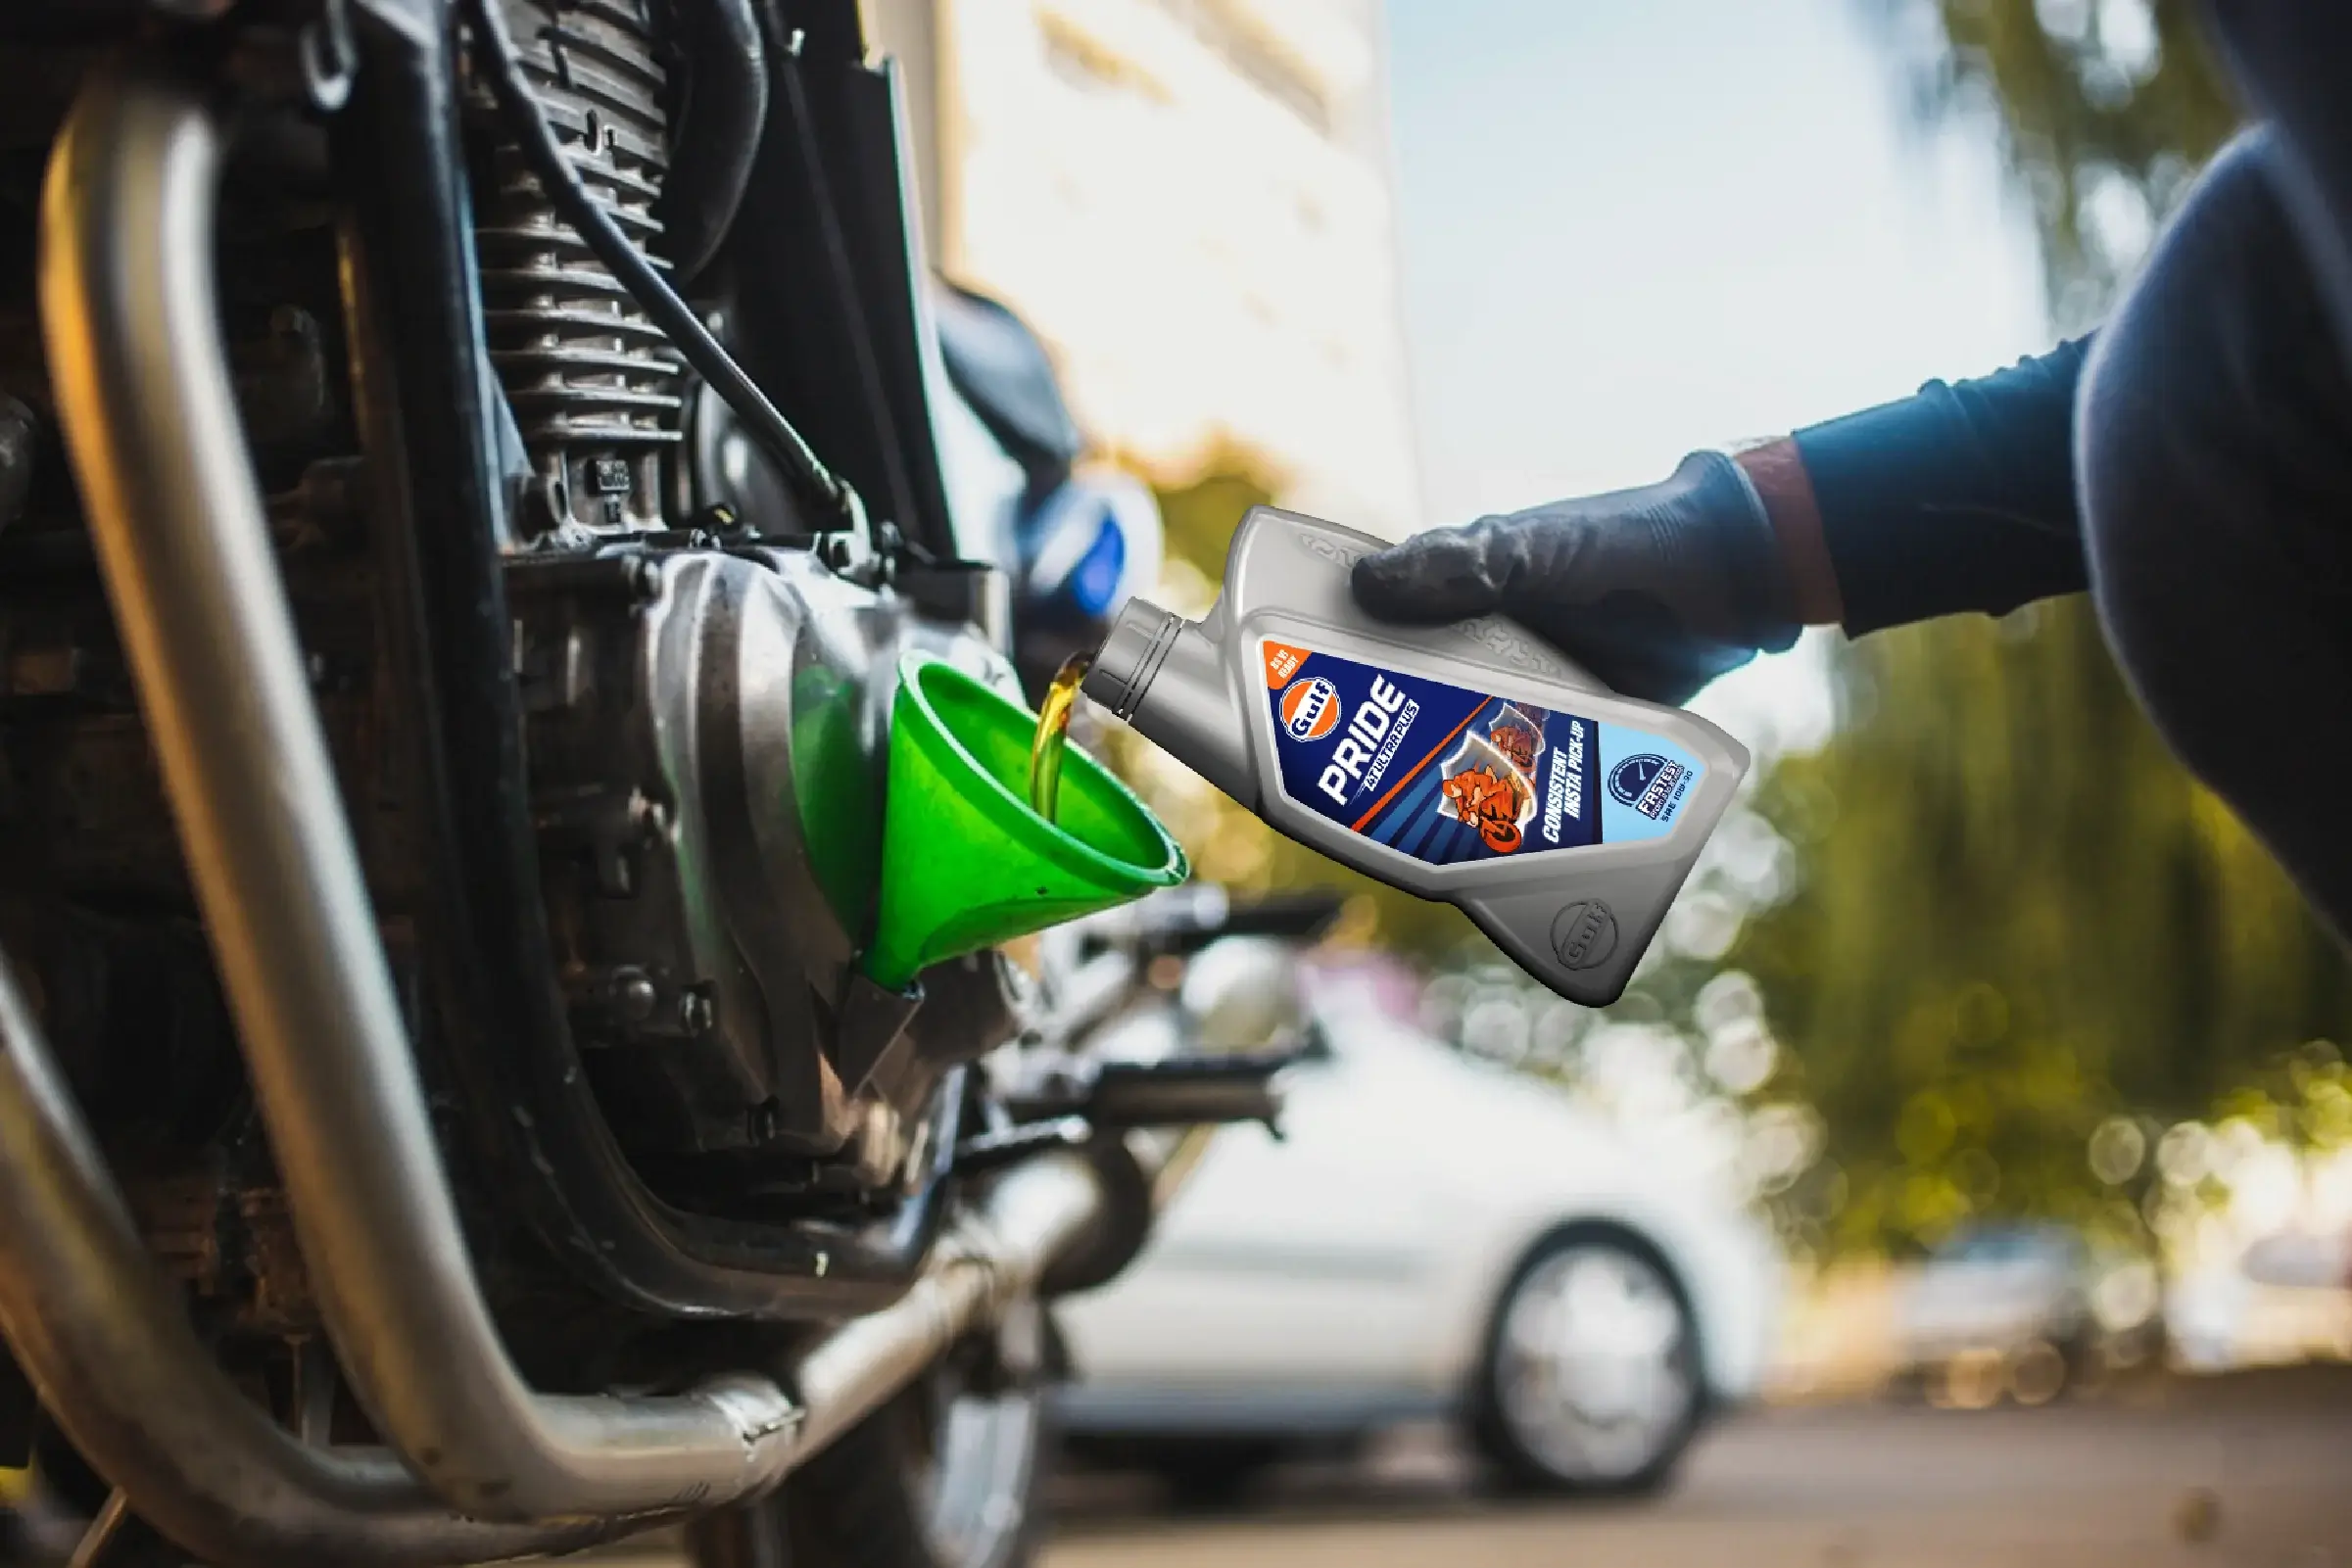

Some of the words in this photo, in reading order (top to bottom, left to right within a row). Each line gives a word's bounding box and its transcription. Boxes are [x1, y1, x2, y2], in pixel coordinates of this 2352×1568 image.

[1291, 681, 1330, 736] Gulf
[1317, 673, 1407, 806] PRIDE
[1568, 720, 1584, 772] PICK-UP
[1542, 745, 1567, 843] CONSISTENT
[1564, 772, 1582, 820] INSTA
[1638, 760, 1678, 814] FASTEST
[1568, 901, 1608, 960] Gulf
